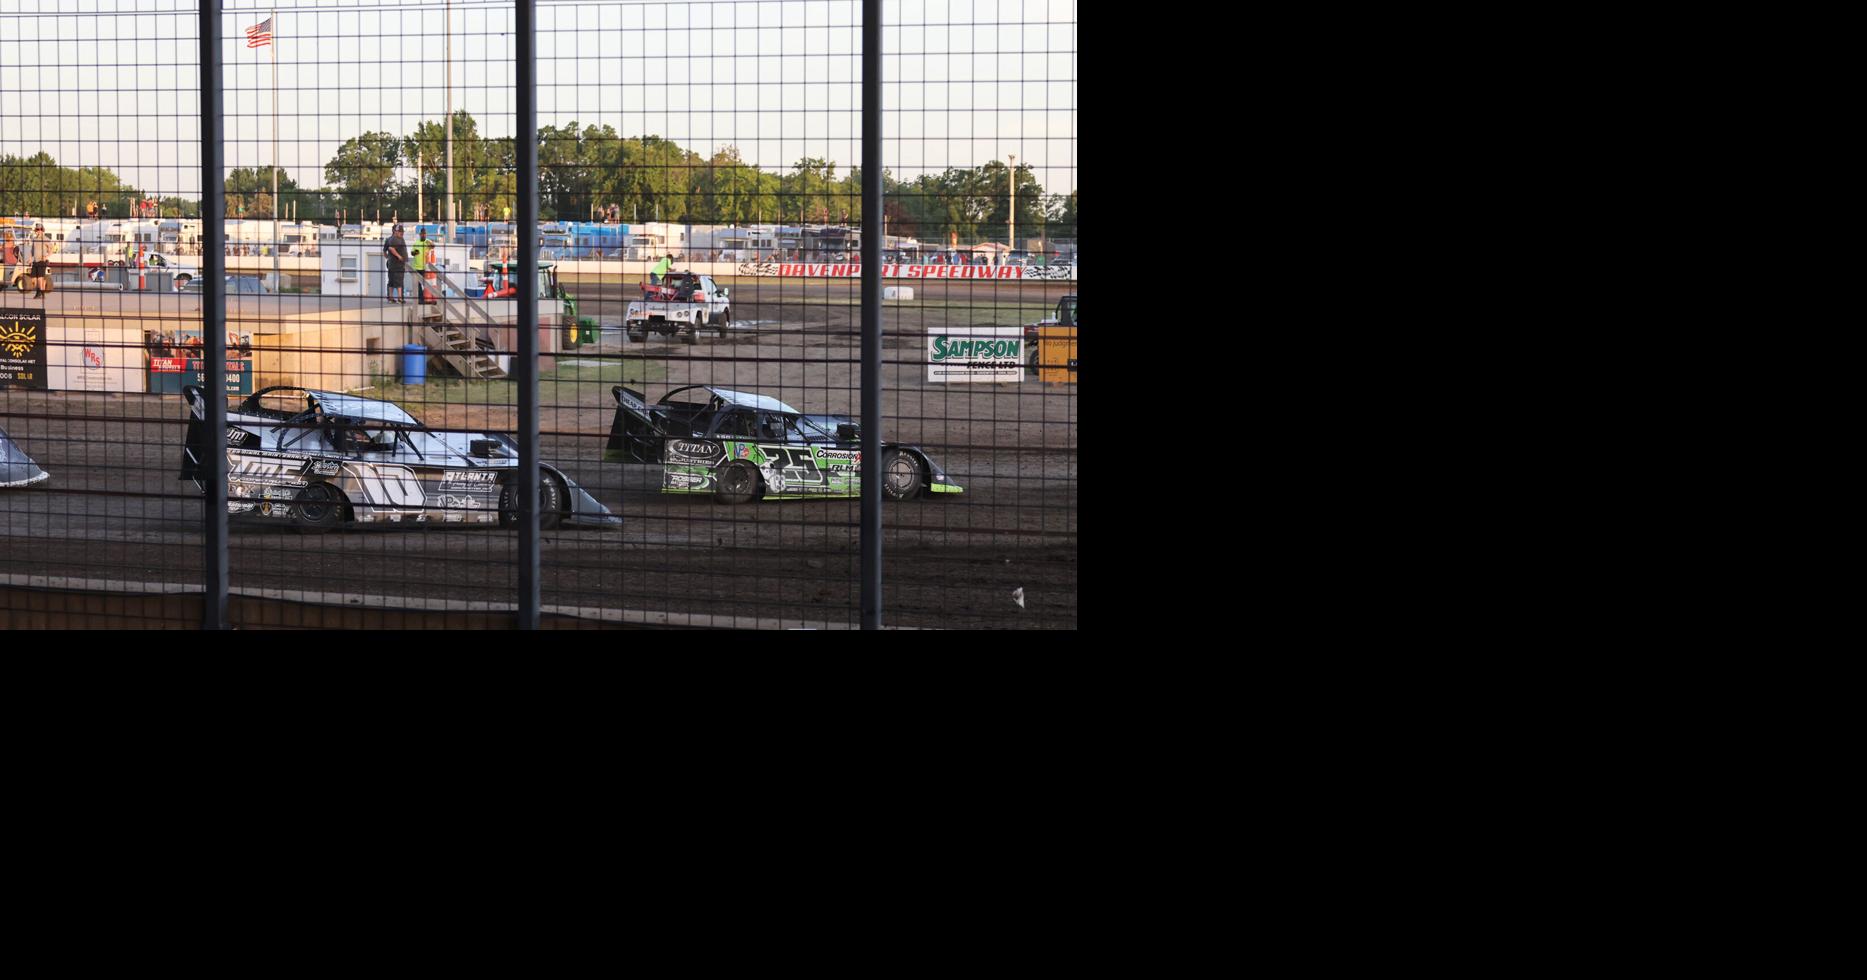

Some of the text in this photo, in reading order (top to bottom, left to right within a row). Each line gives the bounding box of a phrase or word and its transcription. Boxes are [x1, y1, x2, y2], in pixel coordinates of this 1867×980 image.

[907, 265, 1028, 278] SPEEDWAY
[931, 335, 1020, 361] SAMPSON
[83, 348, 100, 367] WRS
[967, 361, 996, 370] FENCE
[998, 361, 1017, 369] LTD
[678, 443, 716, 455] TITAN
[446, 471, 496, 481] ATLANTA
[346, 463, 426, 509] 10
